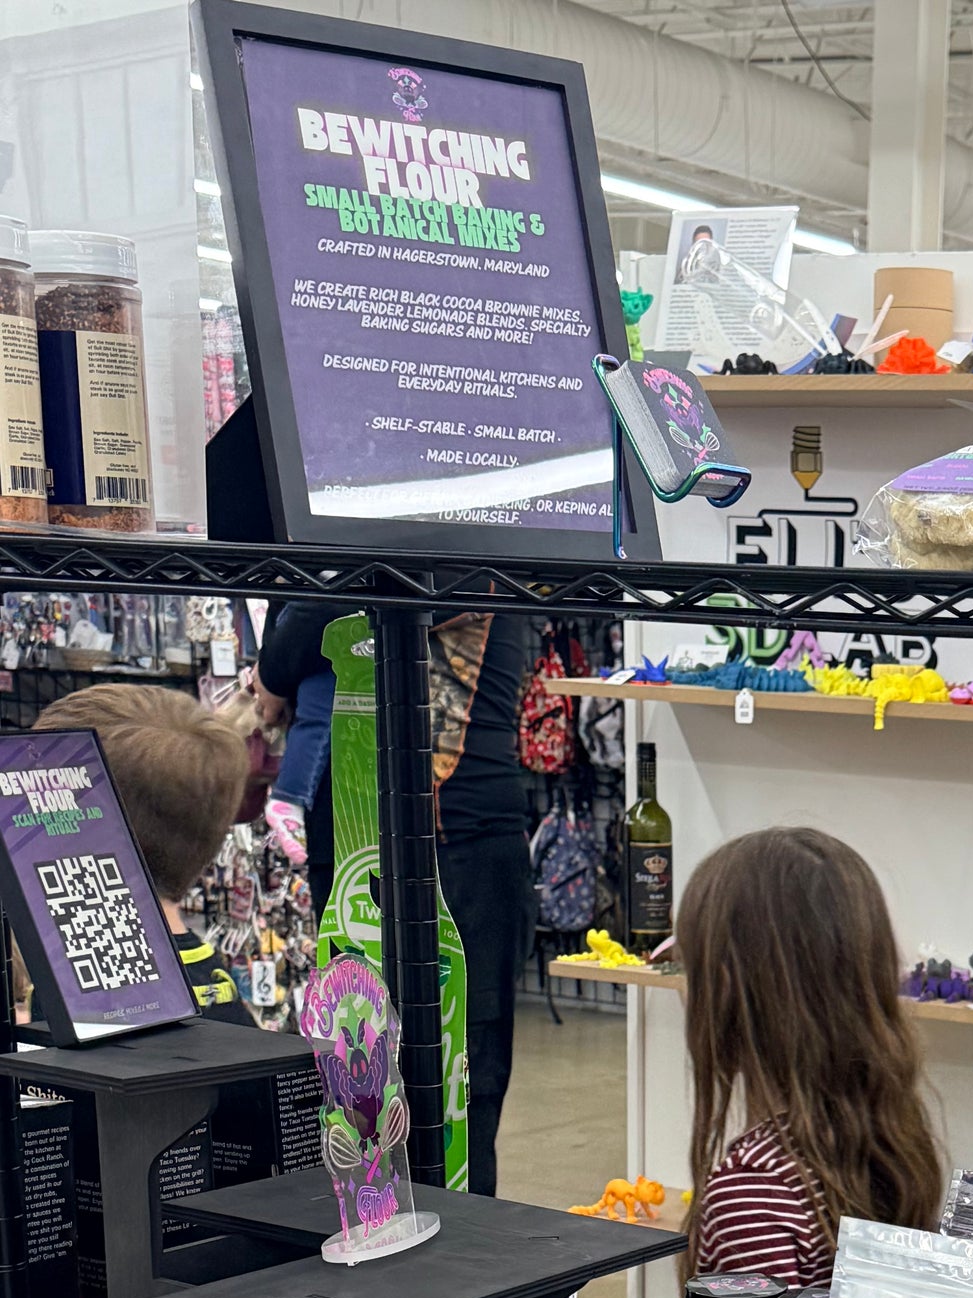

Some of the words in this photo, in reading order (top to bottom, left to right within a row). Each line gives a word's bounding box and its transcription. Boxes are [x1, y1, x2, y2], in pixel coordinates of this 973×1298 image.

[297, 107, 531, 180] BEWITCHING
[363, 155, 483, 208] FLOUR
[304, 184, 376, 214] SMALL
[379, 193, 449, 223] BATCH
[451, 203, 526, 233] BAKING
[529, 213, 545, 235] &
[338, 209, 455, 244] BOTANICAL
[456, 223, 521, 252] MIXES
[317, 238, 376, 257] CRAFTED
[378, 245, 391, 258] IN
[484, 258, 550, 278] MARYLAND
[294, 279, 315, 293] WE
[317, 281, 367, 299] CREATE
[369, 287, 398, 302] RICH
[401, 290, 440, 307] BLACK
[442, 295, 482, 310] COCOA
[485, 300, 541, 318] BROWNIE
[290, 293, 336, 310] HONEY
[337, 299, 405, 317] LAVENDER
[406, 307, 475, 325] LEMONADE
[530, 319, 591, 337] SPECIALTY
[361, 315, 410, 332] BAKING
[411, 321, 464, 337] SUGARS
[466, 327, 492, 340] AND
[494, 331, 534, 345] MORE!
[323, 354, 389, 372] DESIGNED
[390, 360, 417, 375] FOR
[419, 363, 498, 383] INTENTIONAL
[499, 370, 557, 388] KITCHENS
[558, 377, 583, 391] AND
[398, 375, 462, 394] EVERYDAY
[463, 383, 517, 399] RITUALS.
[371, 416, 467, 436] SHELF-STABLE
[473, 425, 517, 440] SMALL
[518, 428, 555, 443] BATCH
[426, 449, 463, 464] MADE
[536, 500, 553, 512] OR
[555, 501, 598, 515] KEPING
[438, 509, 453, 520] TO
[454, 509, 522, 524] YOURSELF.
[0, 766, 93, 796] BEWITCHING
[27, 789, 79, 814] FLOUR
[86, 807, 103, 820] AND
[45, 820, 81, 836] RITUALS
[27, 1128, 50, 1138] gourmet
[51, 1126, 70, 1134] recipes
[35, 1146, 55, 1154] kitchen
[169, 1148, 189, 1156] friends
[31, 1156, 45, 1164] Cock
[174, 1153, 200, 1164] Tuesday?
[30, 1161, 63, 1173] combination
[40, 1172, 57, 1181] spices
[181, 1171, 191, 1179] the
[33, 1183, 46, 1191] used
[163, 1180, 195, 1192] possibilities
[186, 1187, 201, 1195] know
[30, 1199, 51, 1209] created
[53, 1240, 73, 1249] reading
